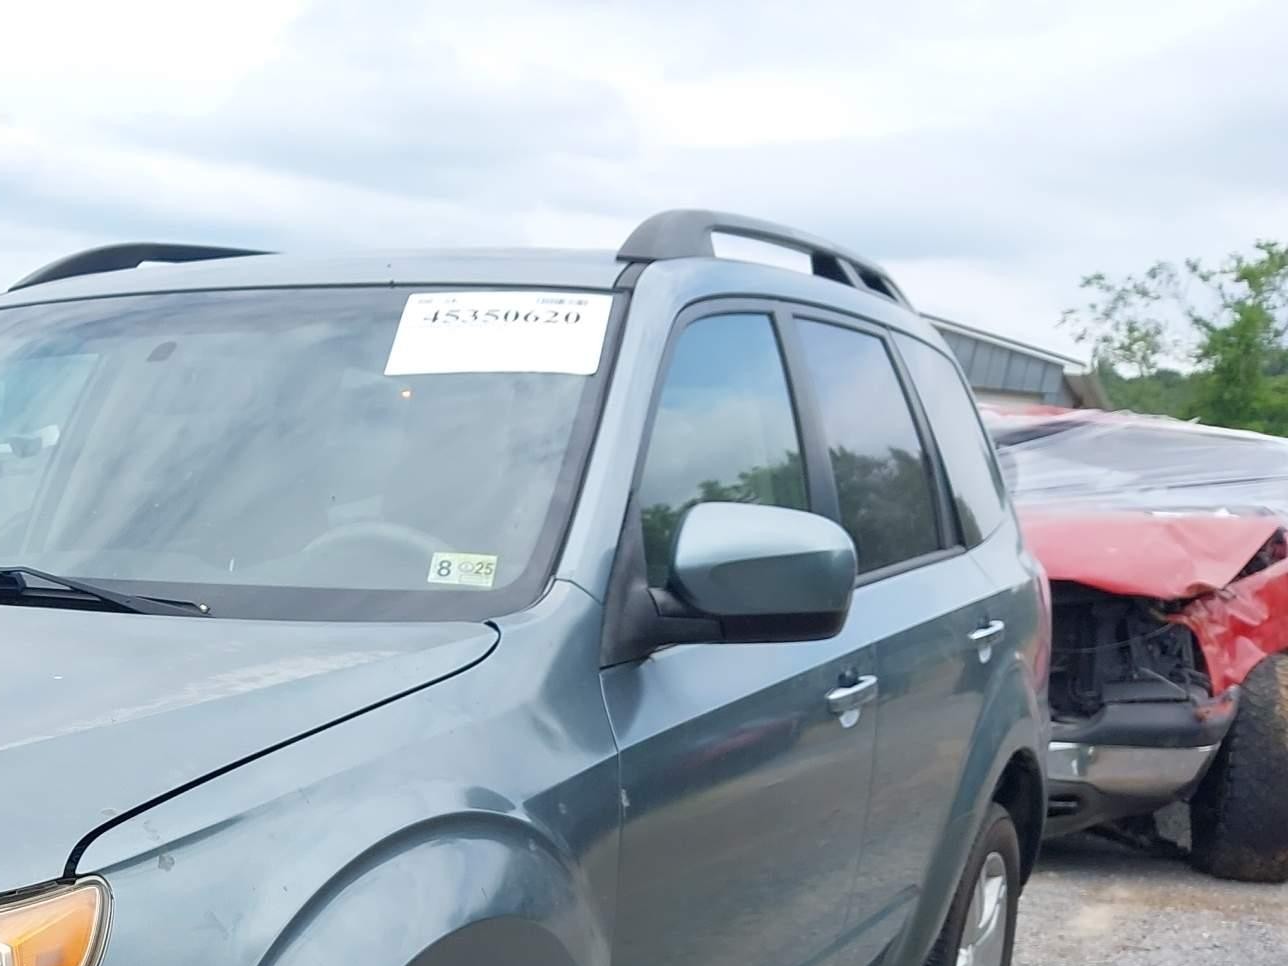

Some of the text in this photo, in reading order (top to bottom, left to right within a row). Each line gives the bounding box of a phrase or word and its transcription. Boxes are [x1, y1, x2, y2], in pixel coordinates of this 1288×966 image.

[423, 308, 581, 324] 45350620
[437, 560, 494, 576] 8 25
